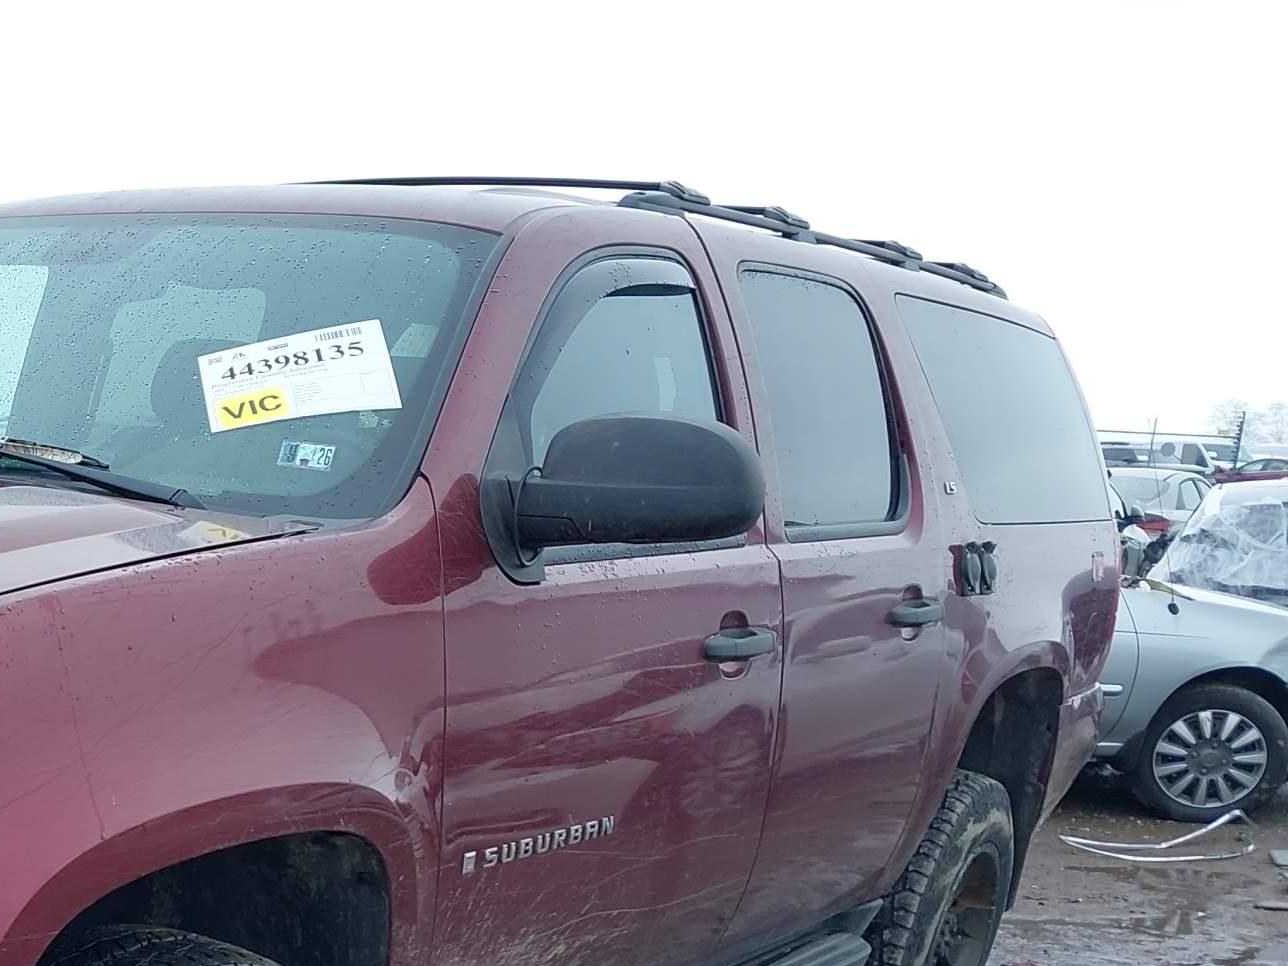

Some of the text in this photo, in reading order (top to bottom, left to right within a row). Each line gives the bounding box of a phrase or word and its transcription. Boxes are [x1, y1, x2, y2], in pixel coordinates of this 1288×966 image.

[220, 341, 365, 380] 44398135
[221, 395, 282, 419] VIC
[316, 447, 332, 465] 26
[483, 815, 616, 868] SUBURBAN
